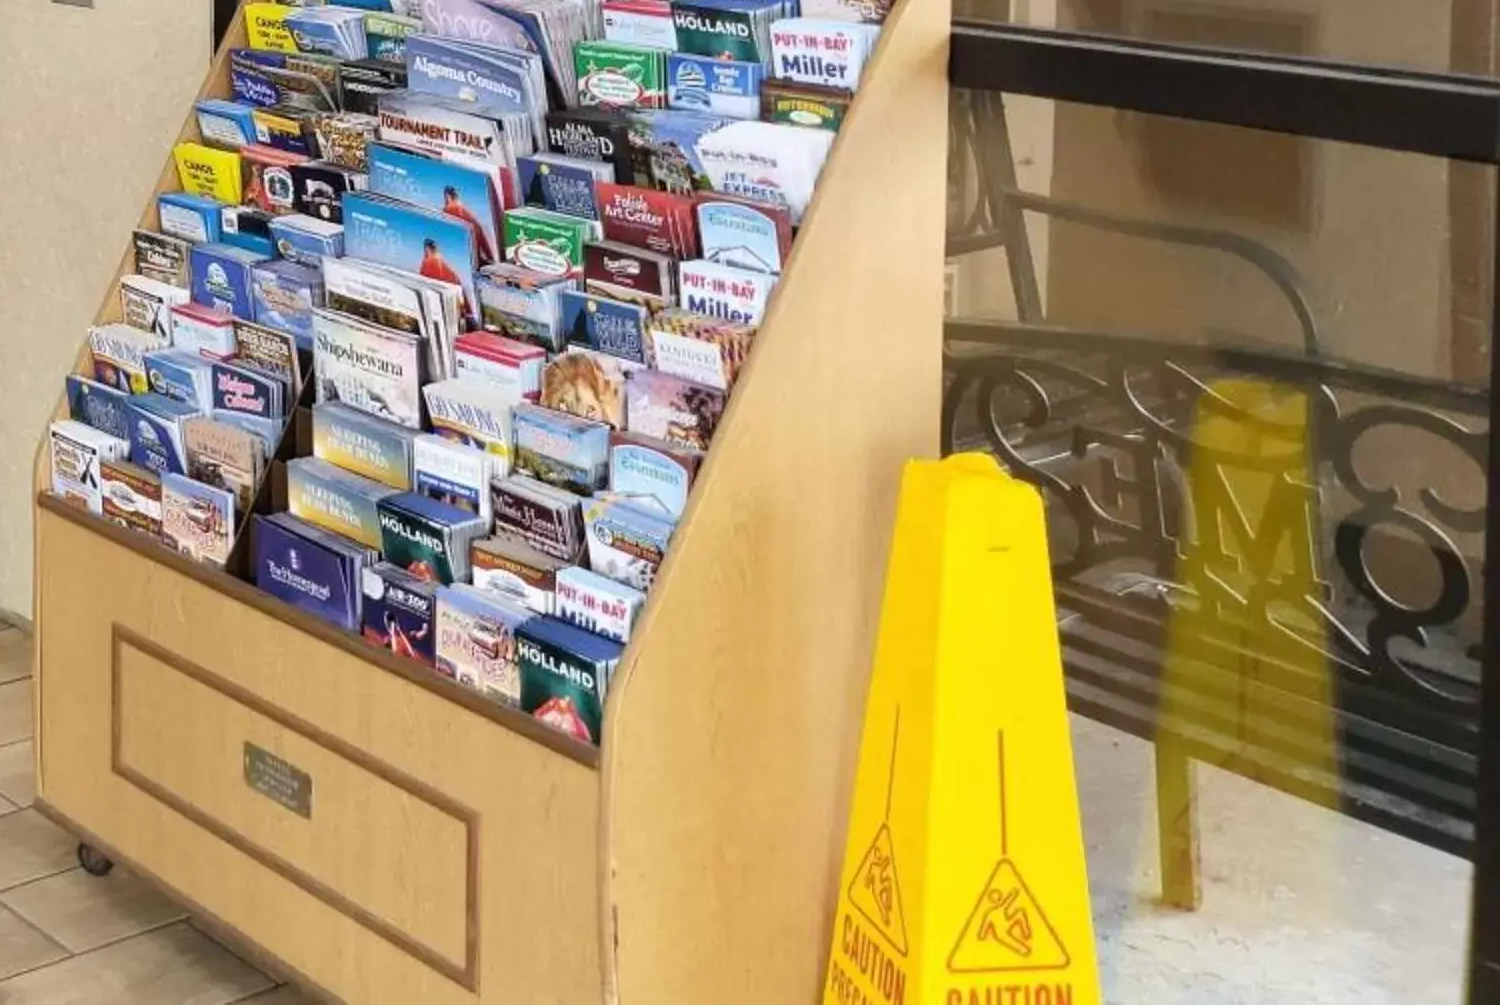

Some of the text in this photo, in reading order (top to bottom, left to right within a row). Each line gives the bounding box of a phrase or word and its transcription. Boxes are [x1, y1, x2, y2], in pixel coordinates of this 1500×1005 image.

[674, 14, 749, 38] HOLLAND
[413, 55, 522, 104] Algoma Country
[782, 55, 849, 80] Miller
[380, 113, 451, 143] TOURNAMENT
[688, 295, 753, 324] Miller
[317, 331, 404, 378] Shipshewana
[381, 513, 443, 552] HOLLAND
[557, 581, 627, 620] PUT-IN-BAY
[518, 643, 594, 689] HOLLAND
[842, 914, 906, 1005] CAUTION
